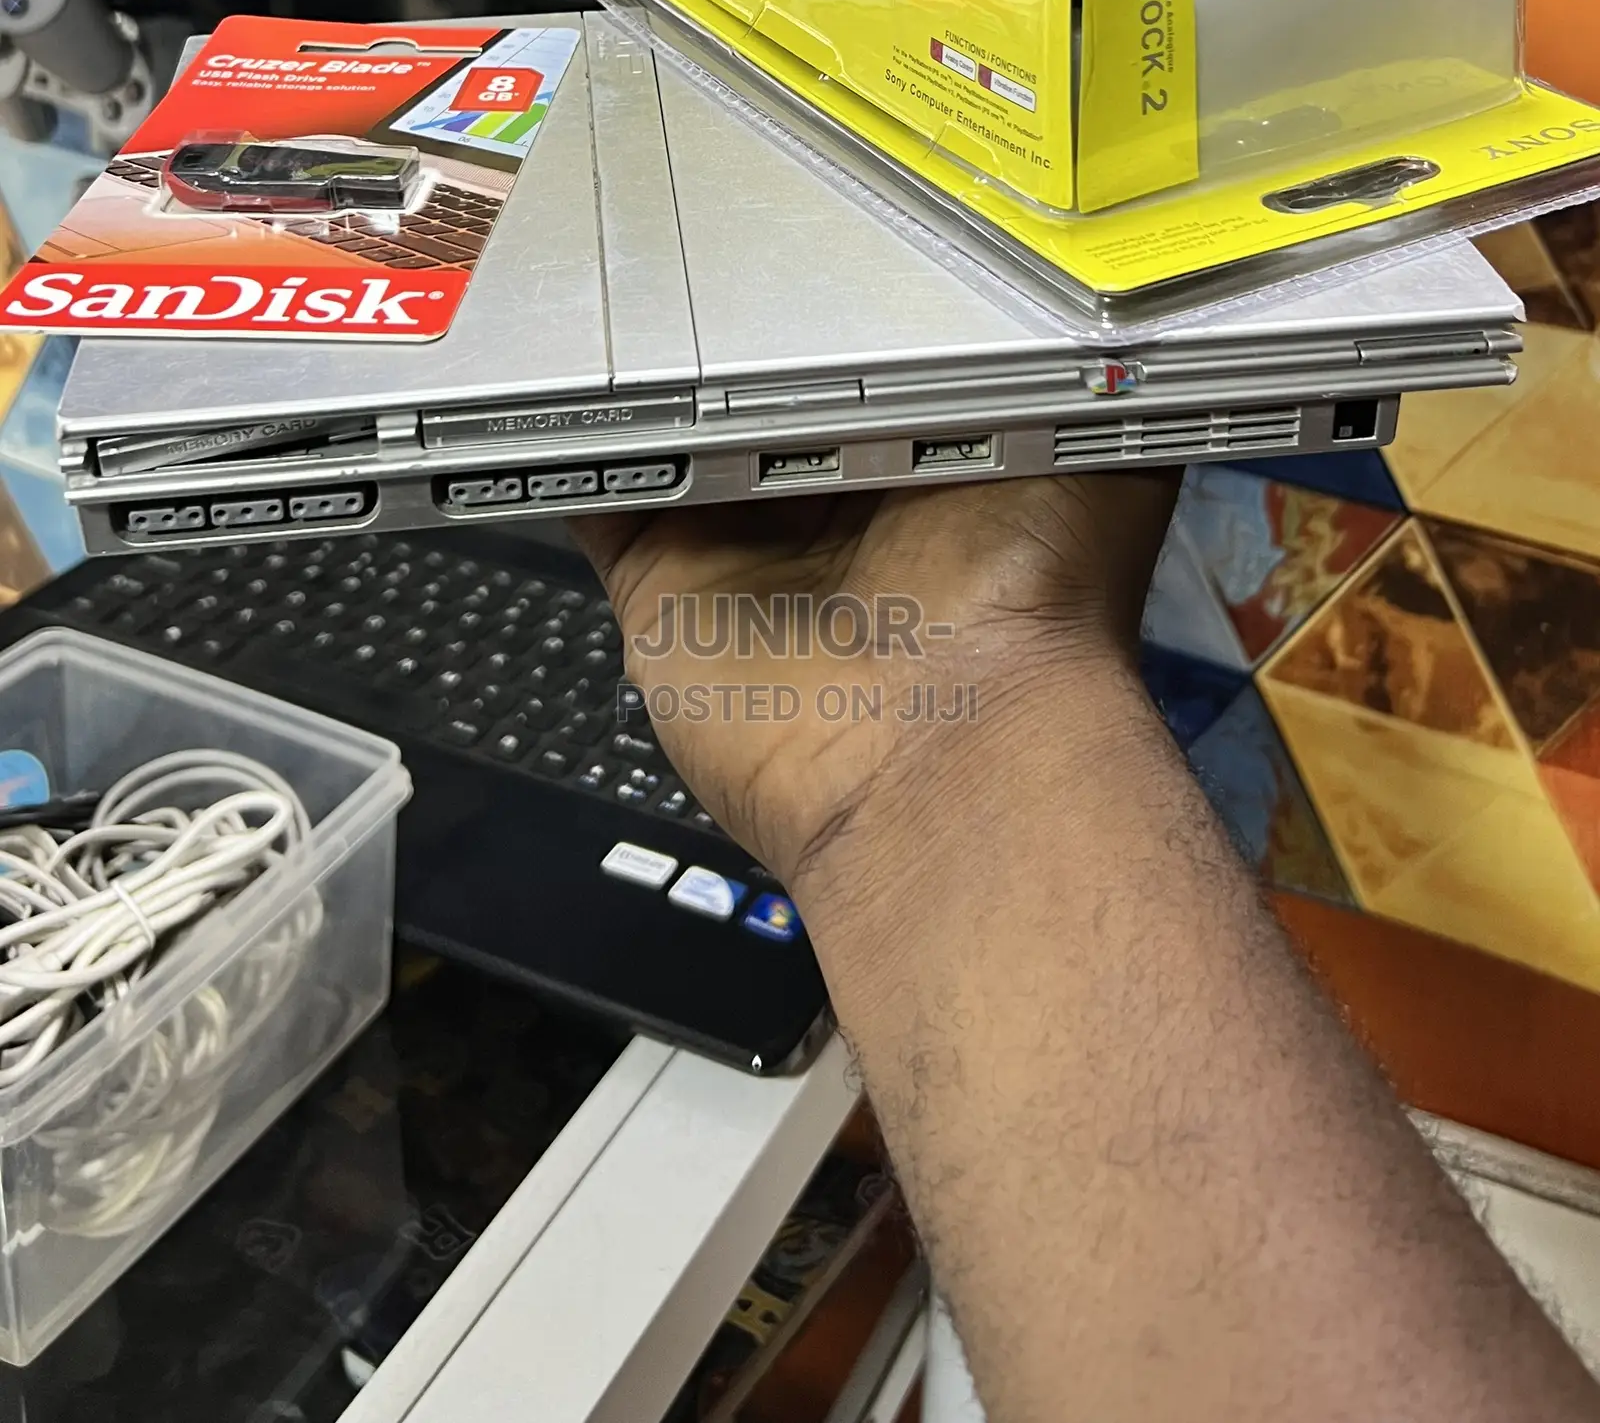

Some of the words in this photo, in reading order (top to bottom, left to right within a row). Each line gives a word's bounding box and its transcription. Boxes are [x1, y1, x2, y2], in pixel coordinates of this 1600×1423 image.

[207, 54, 317, 73] Cruzer
[945, 30, 986, 60] FUNCTIONS
[990, 53, 1037, 85] FONCTIONS
[199, 70, 233, 79] USB
[237, 72, 280, 82] Flash
[284, 74, 327, 83] Drive
[226, 81, 273, 90] reliable
[275, 83, 323, 92] storage
[326, 84, 376, 92] solution
[487, 76, 516, 92] 8
[885, 68, 908, 92] Sony
[909, 84, 954, 118] Computer
[956, 111, 1028, 159] Entertainment
[1479, 118, 1600, 161] SONY
[486, 412, 573, 432] MEMORY
[580, 408, 633, 424] CARD
[166, 428, 256, 455] MEMORY
[261, 419, 317, 438] CARD
